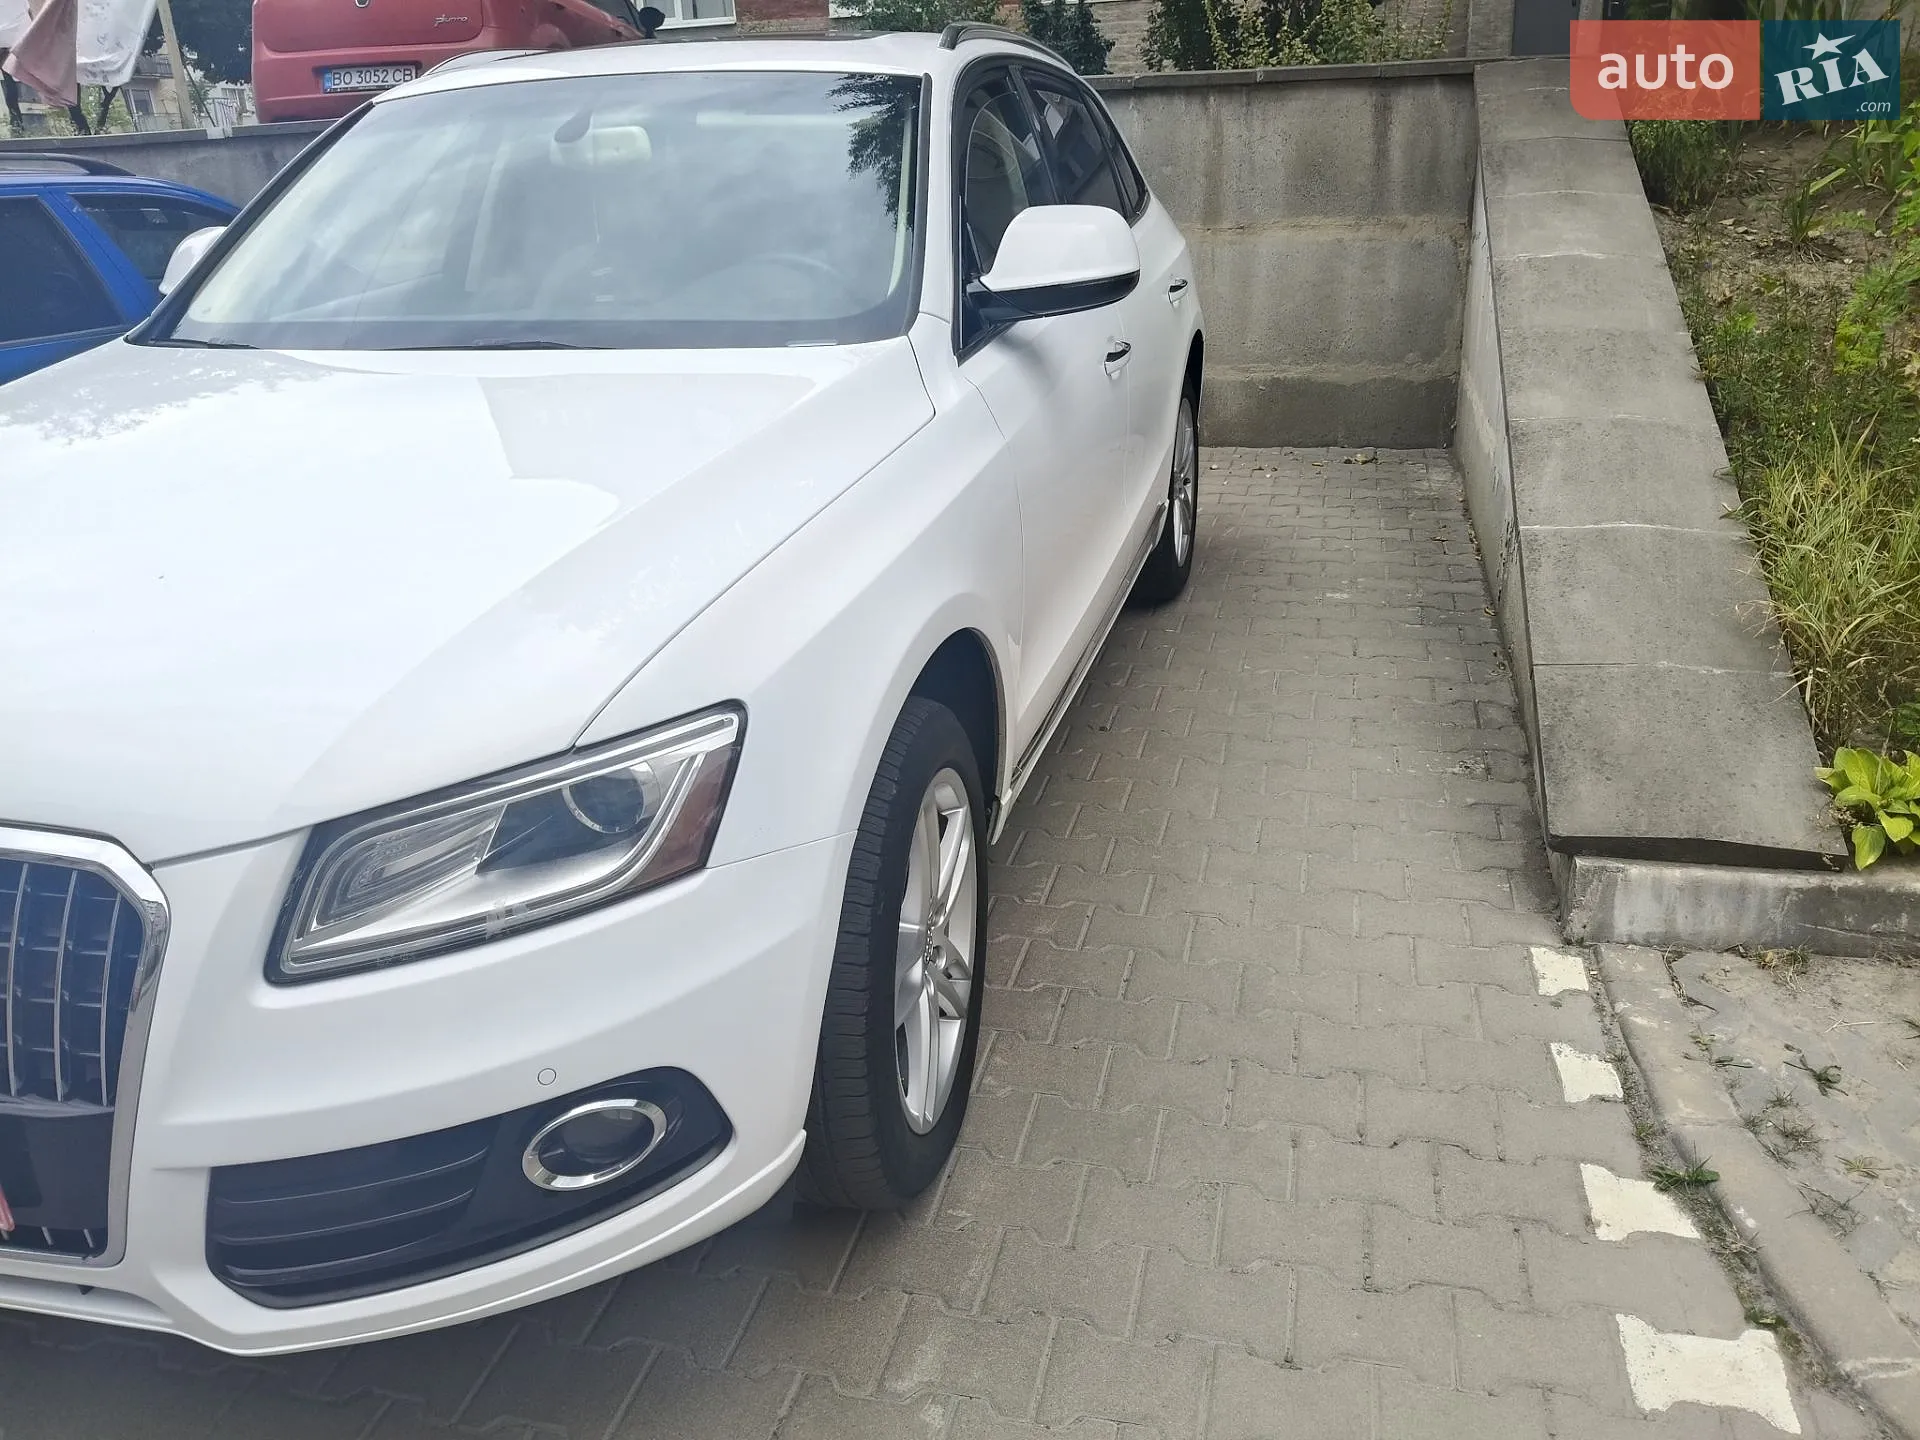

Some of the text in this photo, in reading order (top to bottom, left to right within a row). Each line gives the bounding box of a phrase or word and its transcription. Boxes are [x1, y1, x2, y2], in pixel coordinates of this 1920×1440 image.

[332, 68, 413, 86] BO 3052 CB
